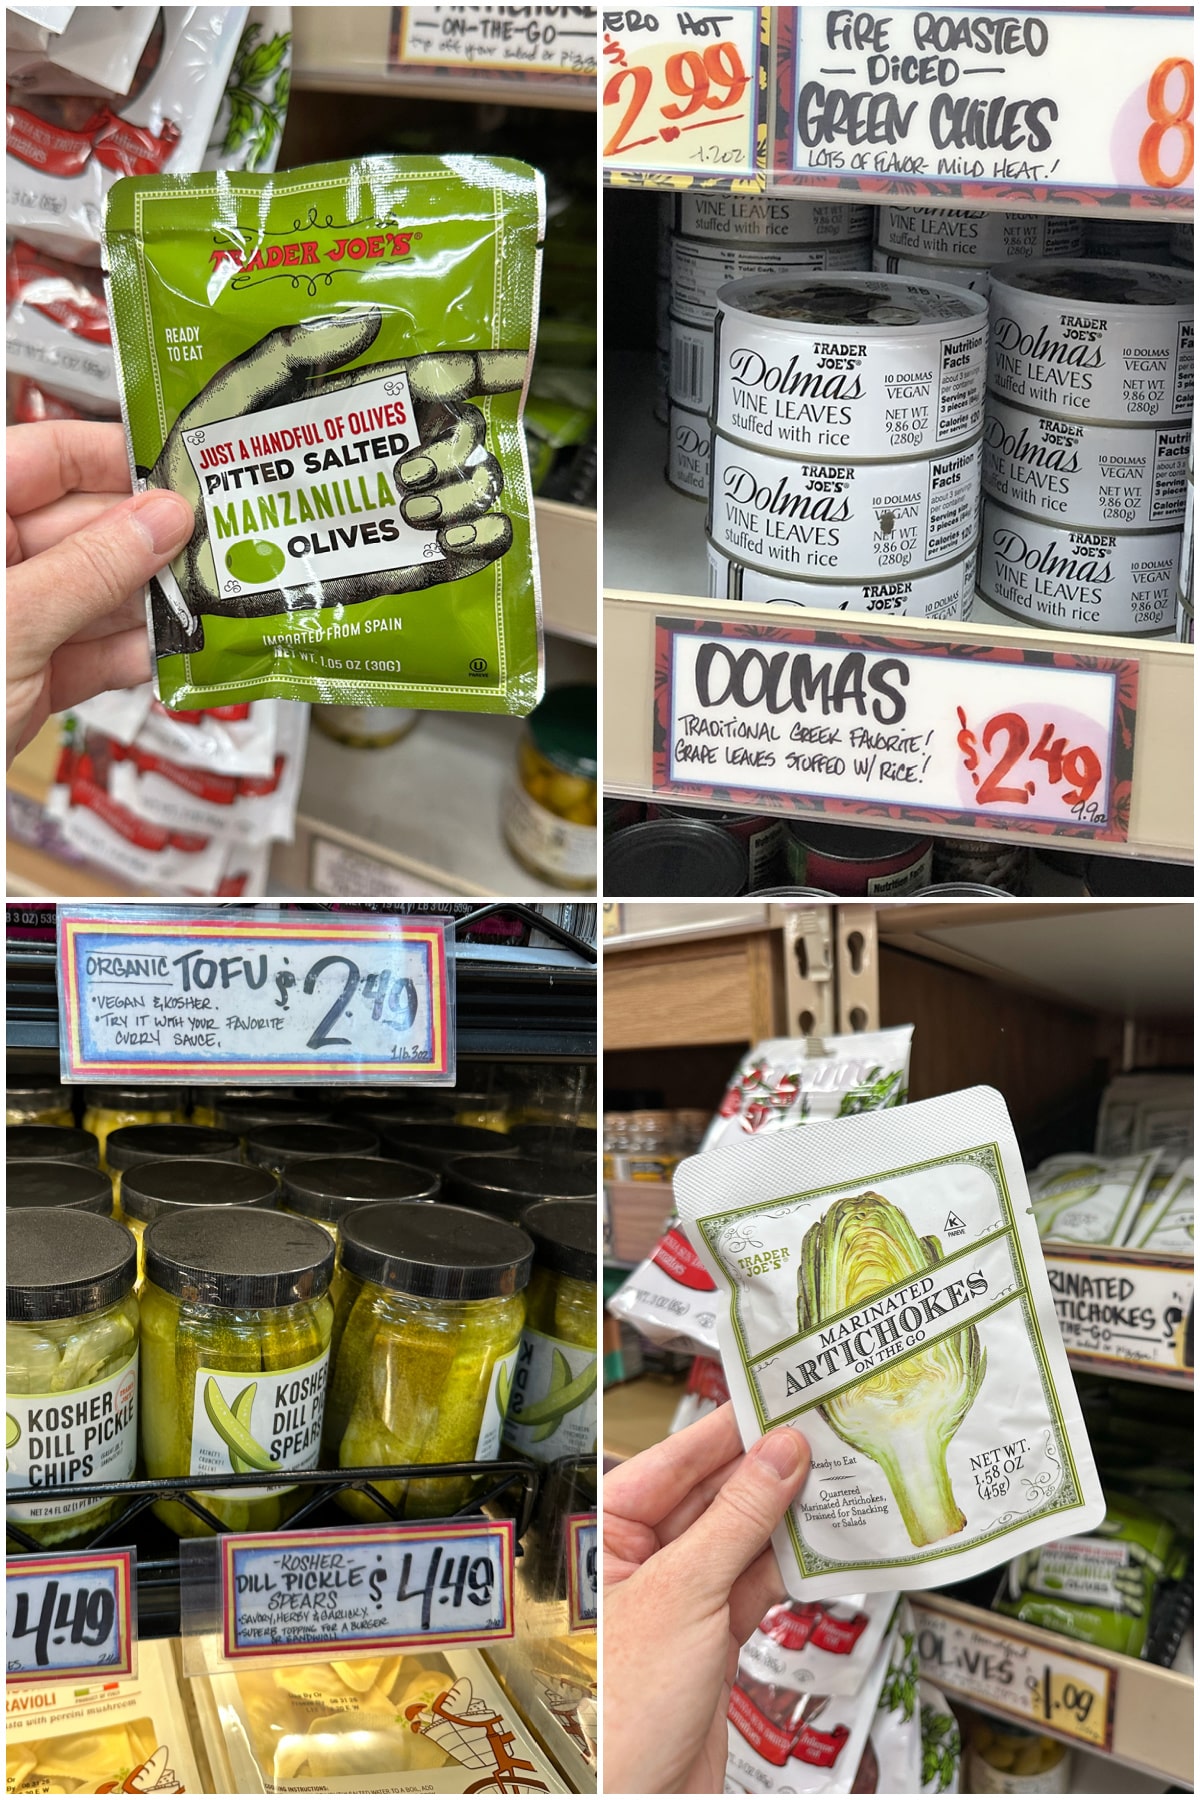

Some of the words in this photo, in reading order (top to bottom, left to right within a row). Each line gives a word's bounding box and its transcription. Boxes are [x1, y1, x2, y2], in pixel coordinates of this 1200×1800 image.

[913, 12, 1049, 57] ROASTED
[798, 81, 918, 148] GREEN
[808, 149, 845, 168] LOTS
[850, 153, 869, 171] OF
[208, 241, 319, 273] TRADER
[165, 326, 200, 344] READY
[813, 342, 867, 357] TRADER
[993, 317, 1106, 369] Dolmas
[167, 347, 181, 362] TO
[183, 345, 203, 361] EAT
[729, 348, 867, 400] Dolmas
[1027, 362, 1093, 390] LEAVES
[732, 386, 768, 415] VINE
[775, 399, 852, 425] LEAVES
[886, 385, 930, 399] VEGAN
[1063, 391, 1091, 409] rice
[199, 442, 236, 469] JUST
[239, 439, 250, 460] A
[250, 423, 324, 457] HANDFUL
[323, 416, 345, 441] OF
[347, 401, 407, 435] OLIVES
[731, 412, 773, 437] stuffed
[778, 425, 811, 444] with
[818, 429, 850, 446] rice
[205, 459, 294, 495] PITTED
[303, 433, 410, 474] SALTED
[801, 465, 855, 480] TRADER
[213, 471, 397, 539] MANZANILLA
[723, 466, 855, 522] Dolmas
[1041, 495, 1068, 513] rice
[287, 519, 400, 558] OLIVES
[725, 502, 759, 533] VINE
[765, 518, 840, 546] LEAVES
[725, 528, 763, 555] stuffed
[768, 544, 800, 564] with
[807, 548, 838, 567] rice
[992, 528, 1116, 584] Dolmas
[994, 561, 1028, 589] VINE
[1034, 577, 1103, 604] LEAVES
[994, 581, 1032, 609] stuffed
[1037, 599, 1066, 618] with
[1072, 607, 1100, 622] rice
[262, 629, 325, 647] IMPORTED
[327, 624, 361, 641] FROM
[365, 618, 402, 633] SPAIN
[300, 652, 318, 665] WT.
[321, 655, 342, 669] 1.05
[347, 660, 362, 671] OZ
[365, 659, 401, 672] (30G)
[695, 642, 910, 725] DOLMAS
[790, 722, 842, 744] GREEK
[674, 743, 719, 766] GRAPE
[725, 745, 776, 767] LEAVES
[785, 752, 846, 776] STUFFED
[854, 755, 878, 782] W/
[86, 955, 170, 979] ORGANIC
[173, 949, 268, 993] TOFU
[136, 1015, 149, 1027] IT
[154, 1016, 185, 1029] WITH
[187, 1017, 219, 1030] YOUR
[225, 1017, 285, 1031] FAVORITE
[115, 1032, 161, 1047] CURRY
[947, 1228, 966, 1238] PAREVE
[737, 1247, 790, 1270] TRADER
[818, 1277, 935, 1348] MARINATED
[785, 1270, 989, 1398] ARTICHOKES
[854, 1355, 874, 1374] ON
[874, 1341, 904, 1365] THE
[906, 1330, 926, 1348] GO
[28, 1391, 113, 1433] KOSHER
[272, 1405, 306, 1436] DILL
[28, 1433, 75, 1460] DILL
[84, 1397, 134, 1451] PICKLE
[269, 1422, 321, 1461] SPEARS
[28, 1454, 94, 1487] CHIPS
[810, 1459, 833, 1470] Ready
[842, 1457, 857, 1465] Eat
[969, 1446, 1003, 1471] NET
[1003, 1439, 1031, 1457] WT.
[974, 1466, 1001, 1486] 1.58
[1003, 1457, 1025, 1473] OZ
[801, 1500, 840, 1512] Marinated
[841, 1494, 887, 1507] Artichokes,
[819, 1486, 861, 1502] Quartered
[977, 1475, 1011, 1500] (45g)
[30, 1508, 43, 1517] NET
[44, 1506, 53, 1515] 24
[54, 1505, 62, 1514] FL
[63, 1503, 71, 1512] OZ
[805, 1511, 836, 1522] Drained
[837, 1509, 850, 1518] for
[851, 1503, 889, 1515] Snacking
[842, 1517, 867, 1527] Salads
[236, 1574, 277, 1594] DILL
[281, 1565, 366, 1591] PICKLE
[267, 1591, 338, 1611] SPEARS
[281, 1624, 317, 1636] TOPPING
[321, 1623, 337, 1633] FOR
[341, 1622, 348, 1632] A
[350, 1617, 389, 1632] BURGER
[26, 1716, 47, 1728] with
